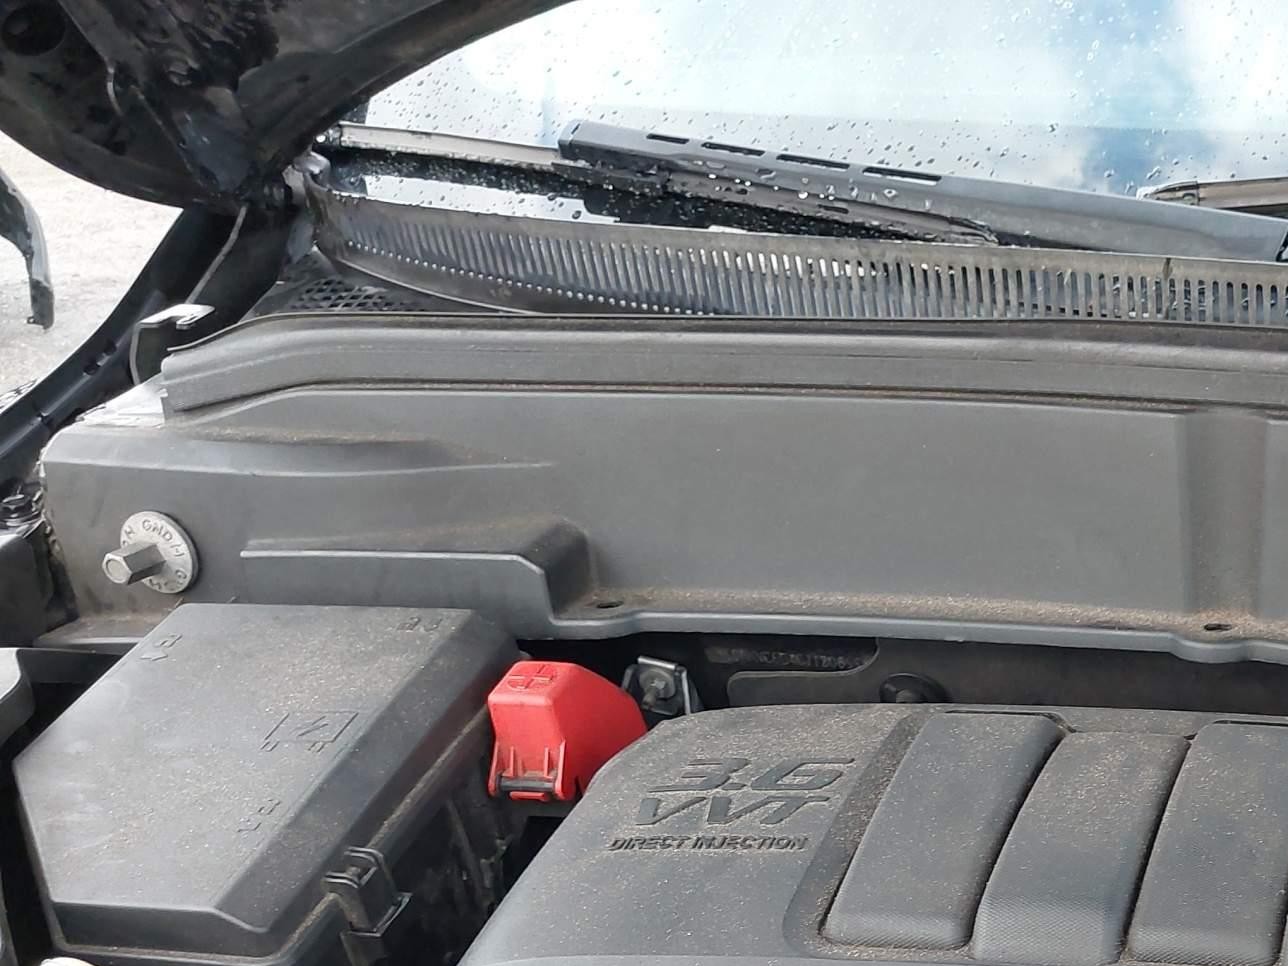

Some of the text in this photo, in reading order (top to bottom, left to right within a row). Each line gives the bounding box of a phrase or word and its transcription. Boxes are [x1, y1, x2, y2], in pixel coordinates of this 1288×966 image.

[650, 757, 856, 793] 3.6
[636, 796, 830, 826] VVT
[609, 836, 809, 851] DIRECT INJECTION
